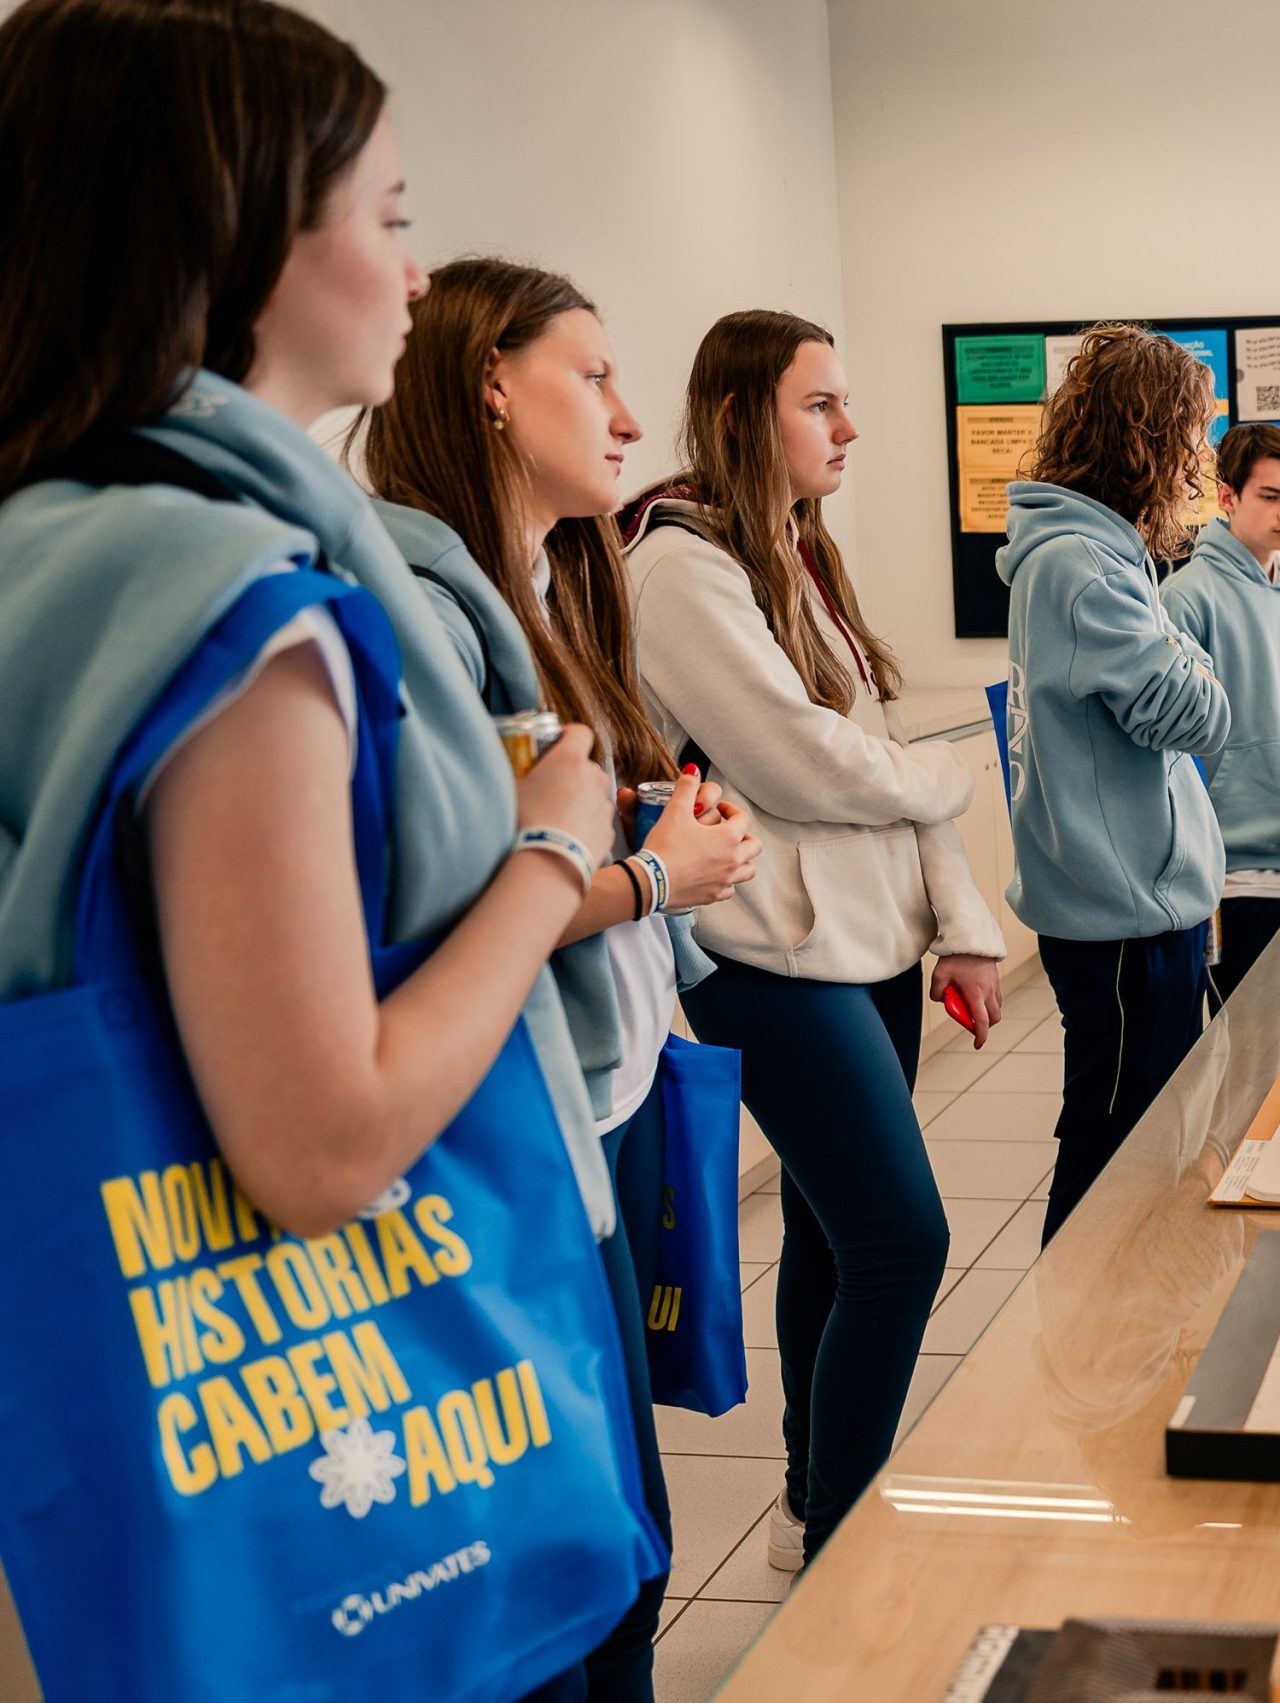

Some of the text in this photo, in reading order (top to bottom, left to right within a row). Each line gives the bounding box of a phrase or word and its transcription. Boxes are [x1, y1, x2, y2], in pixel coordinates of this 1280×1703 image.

[101, 1158, 281, 1279] NOV
[157, 1320, 412, 1496] CABEM
[402, 1359, 552, 1508] AQUI
[371, 1541, 491, 1614] UNIVATES
